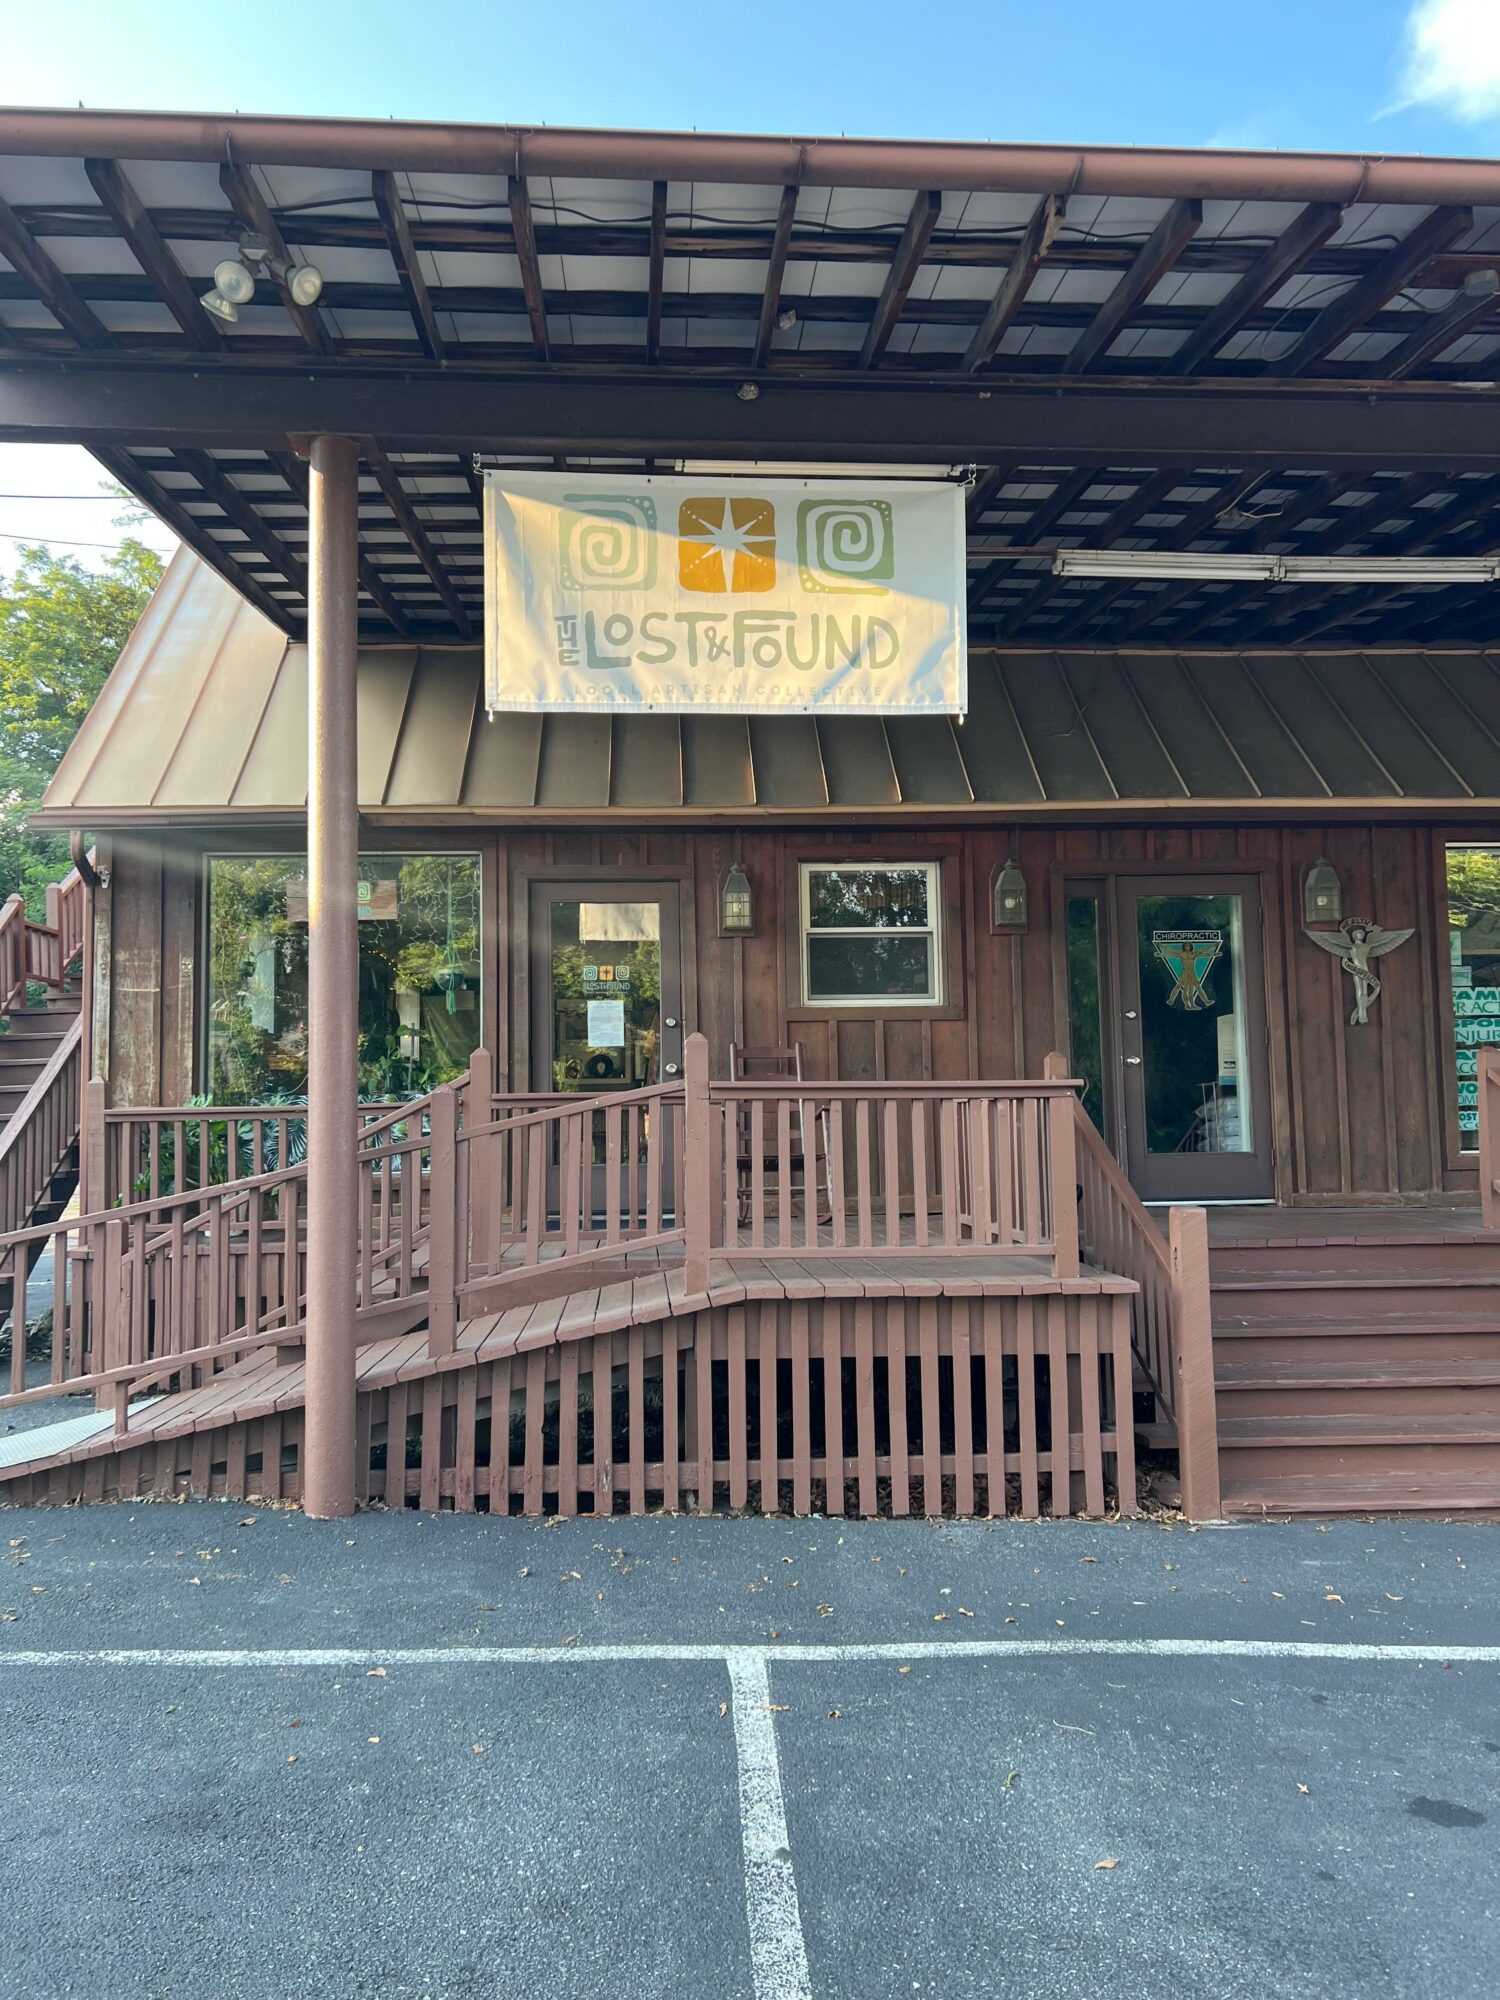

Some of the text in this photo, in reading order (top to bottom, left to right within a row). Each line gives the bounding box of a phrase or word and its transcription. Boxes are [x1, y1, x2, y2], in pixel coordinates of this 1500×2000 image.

[554, 614, 580, 666] THE
[574, 683, 882, 697] LOCAL ARTISAN COLLECTIVE
[1155, 932, 1218, 940] CHIROPRACTIC
